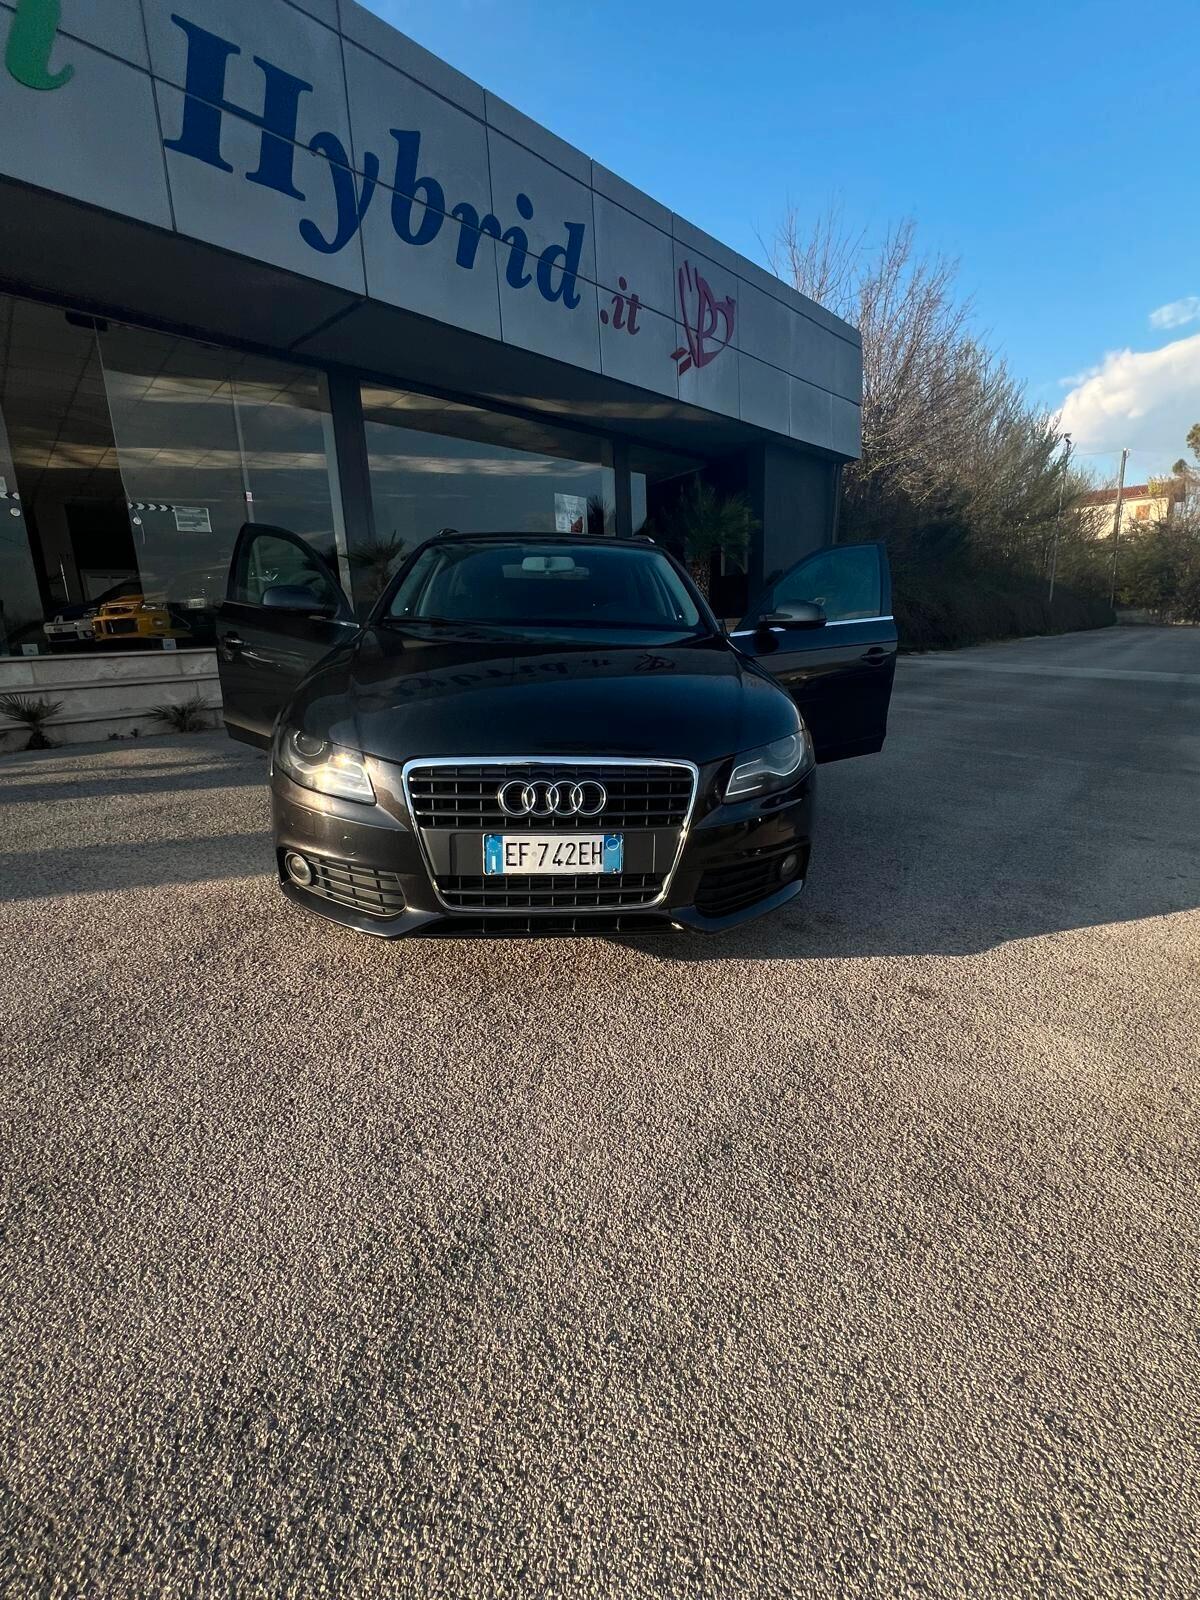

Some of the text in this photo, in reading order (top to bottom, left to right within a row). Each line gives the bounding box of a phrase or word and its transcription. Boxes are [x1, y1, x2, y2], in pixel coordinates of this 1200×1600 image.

[163, 13, 585, 309] Hybrid
[505, 843, 530, 866] EF
[537, 841, 603, 867] 742EH
